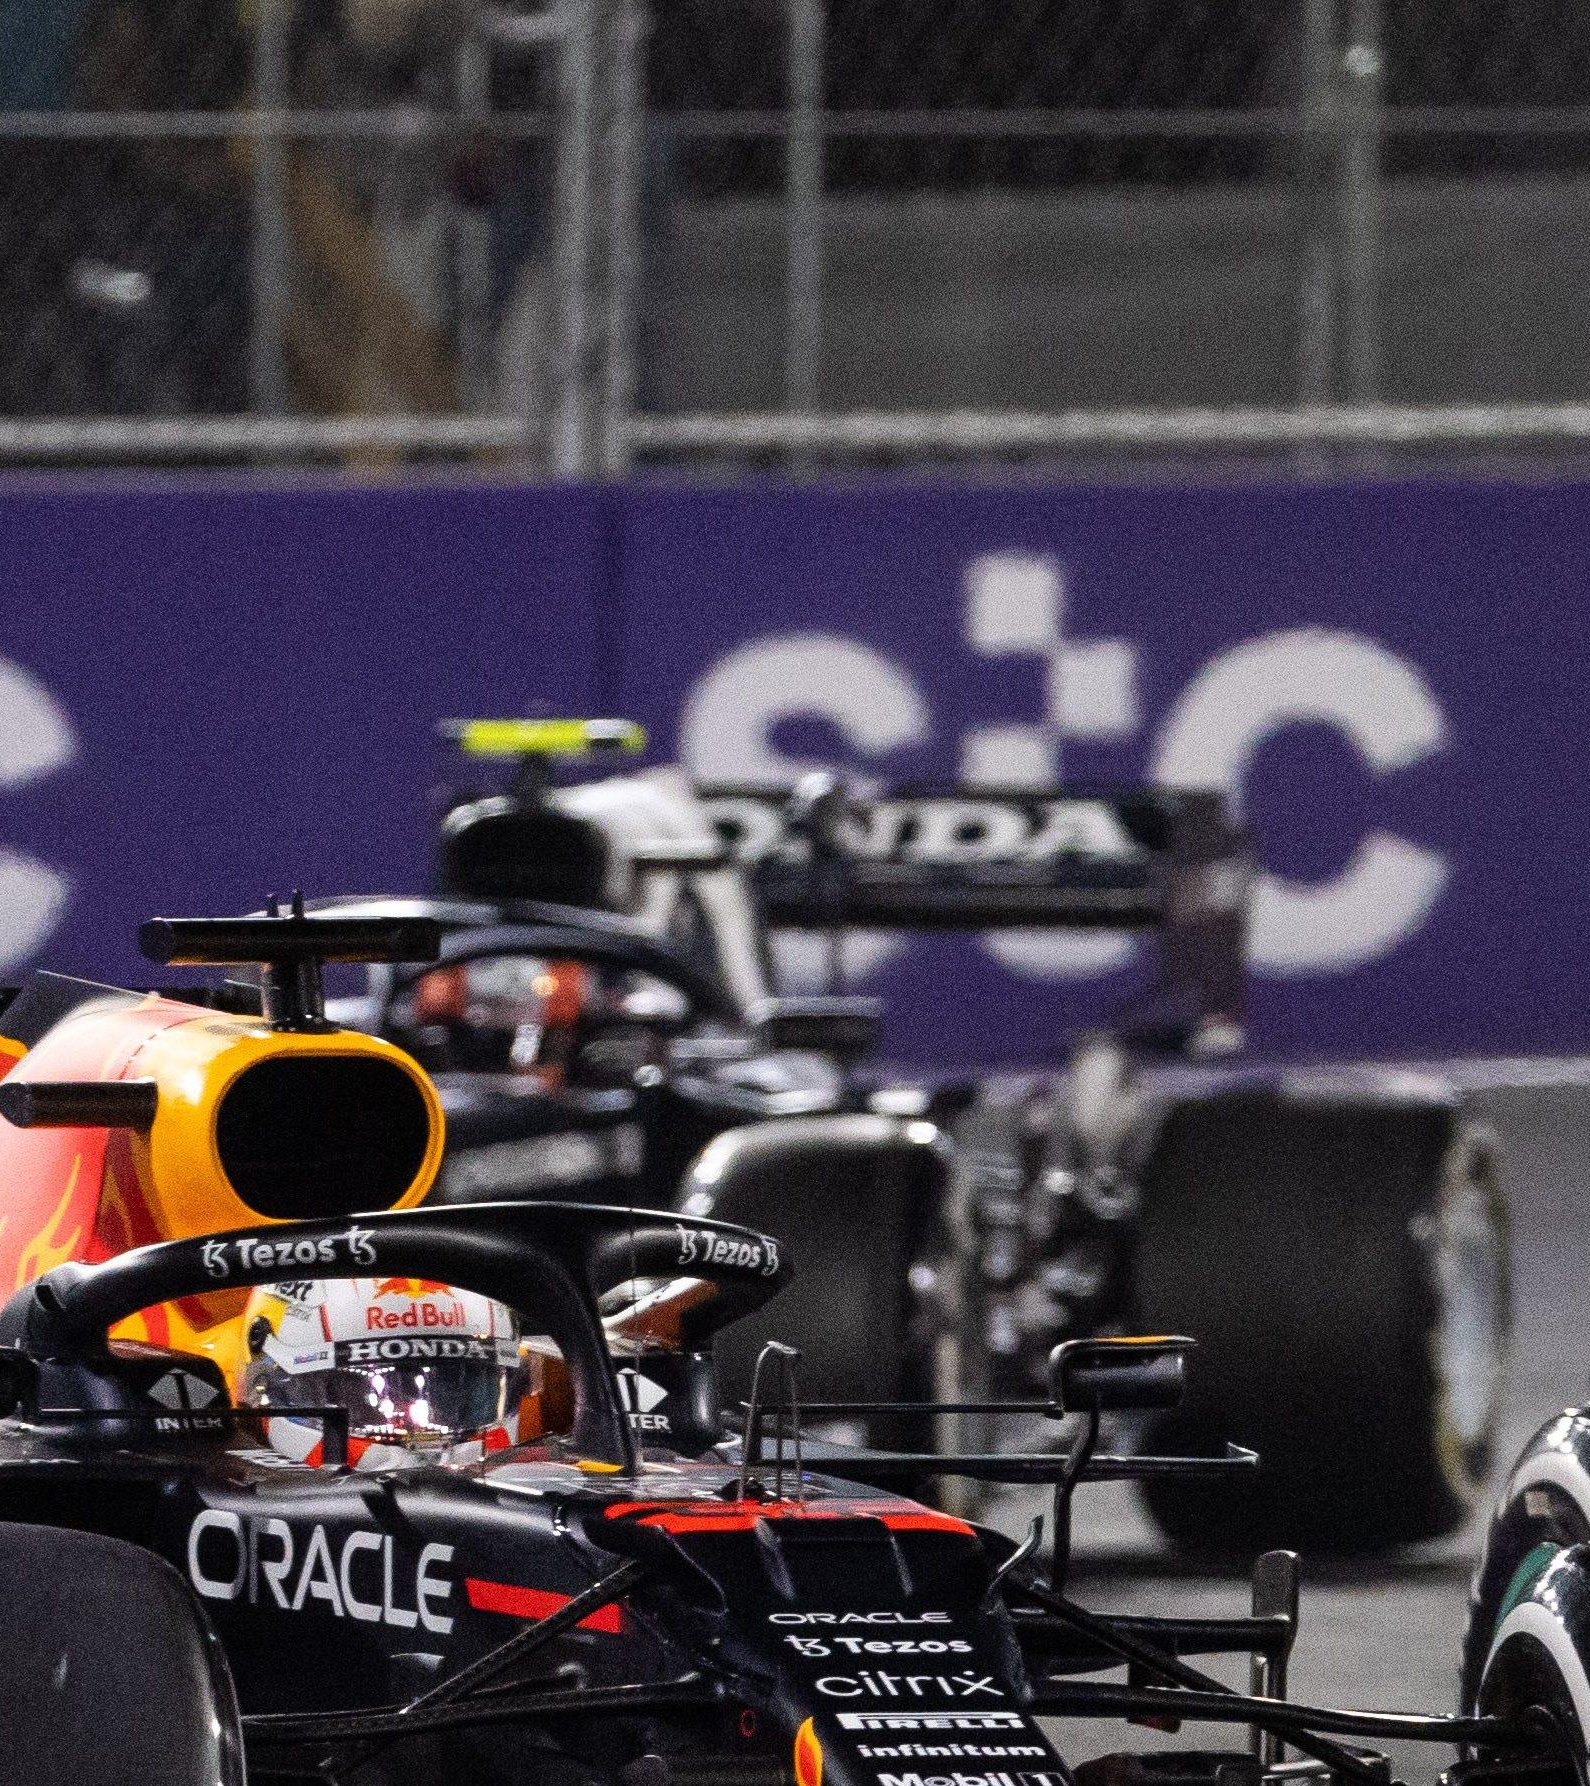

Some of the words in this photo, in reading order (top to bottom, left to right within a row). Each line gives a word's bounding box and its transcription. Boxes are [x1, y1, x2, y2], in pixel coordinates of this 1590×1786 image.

[234, 1235, 336, 1269] Tezos
[701, 1229, 762, 1271] Tezos
[365, 1304, 418, 1331] Red
[423, 1301, 467, 1328] Bull
[349, 1336, 484, 1362] HONDA
[187, 1508, 455, 1635] ORACLE
[768, 1611, 953, 1625] ORACLE
[834, 1636, 973, 1655] Tezos
[835, 1712, 1026, 1730] PIRELLI
[856, 1743, 1046, 1758] infinitum
